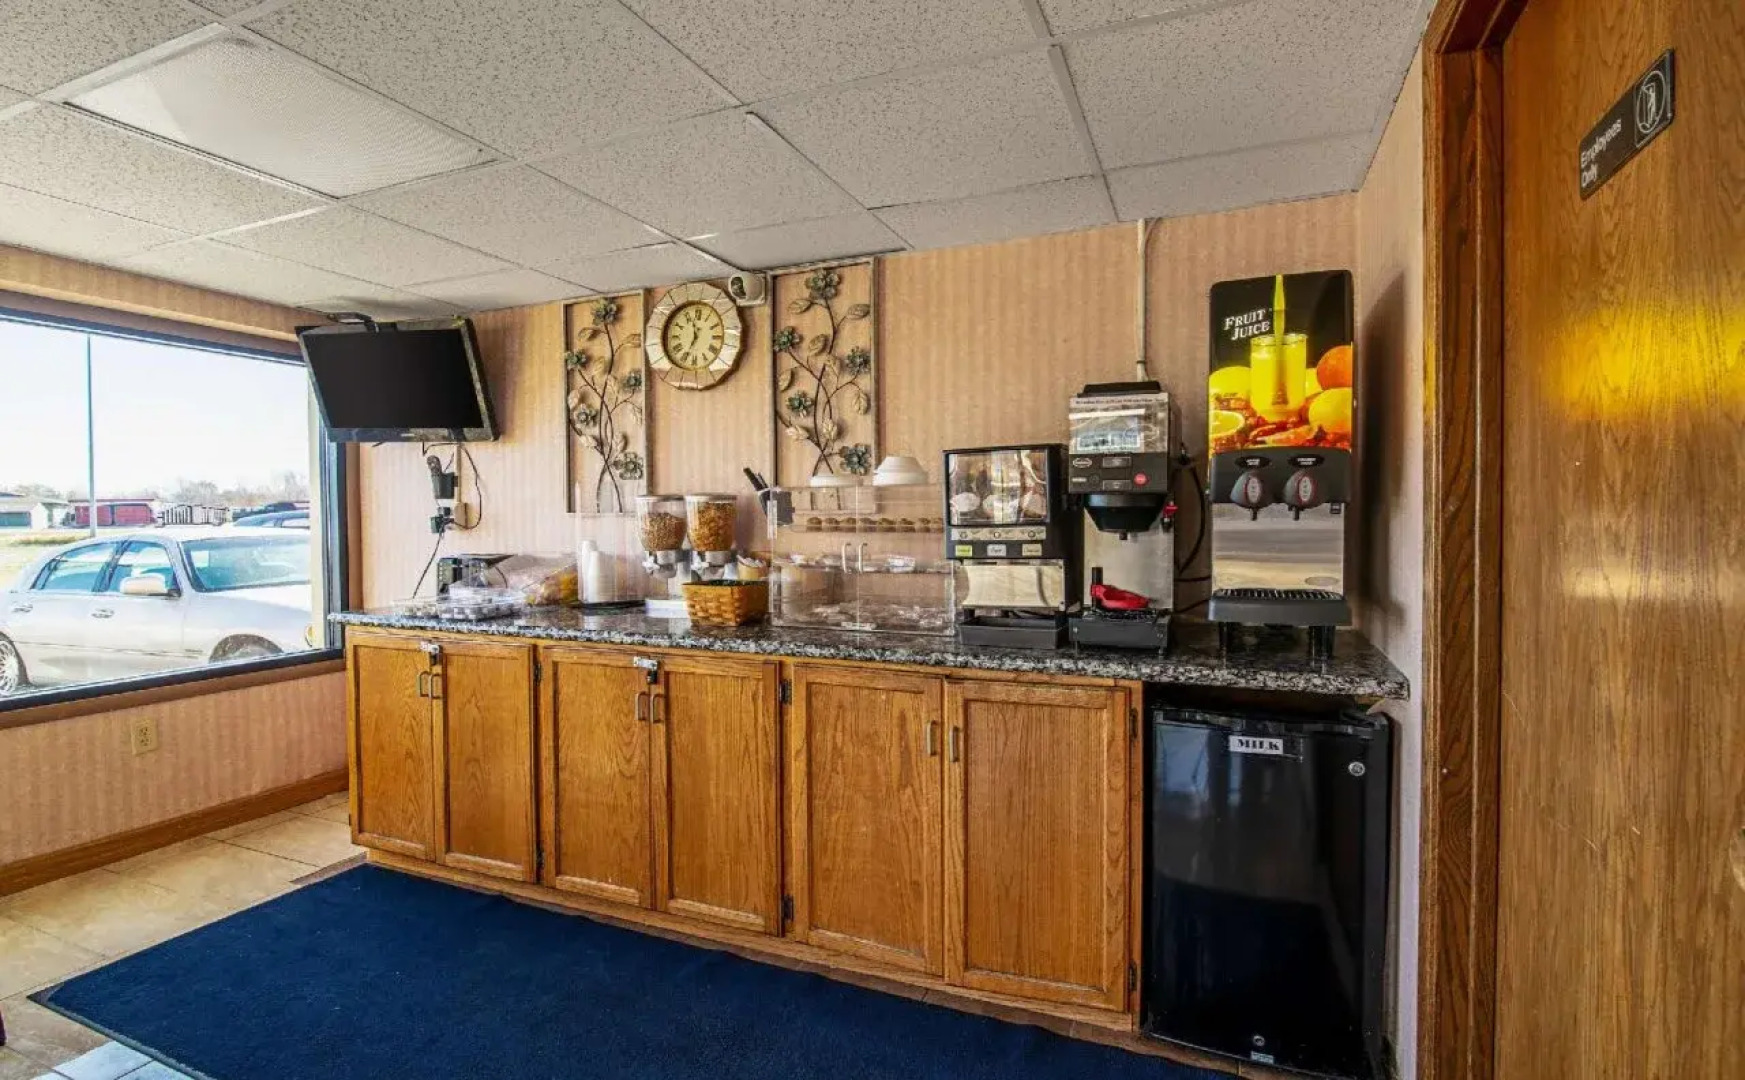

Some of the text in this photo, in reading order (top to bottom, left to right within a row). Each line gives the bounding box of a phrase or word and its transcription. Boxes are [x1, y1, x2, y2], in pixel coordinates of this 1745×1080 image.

[1581, 118, 1622, 169] Employees
[1581, 162, 1598, 188] Only
[1223, 309, 1266, 331] FRUIT
[1231, 321, 1270, 341] JUICE
[1237, 738, 1280, 751] MILK
